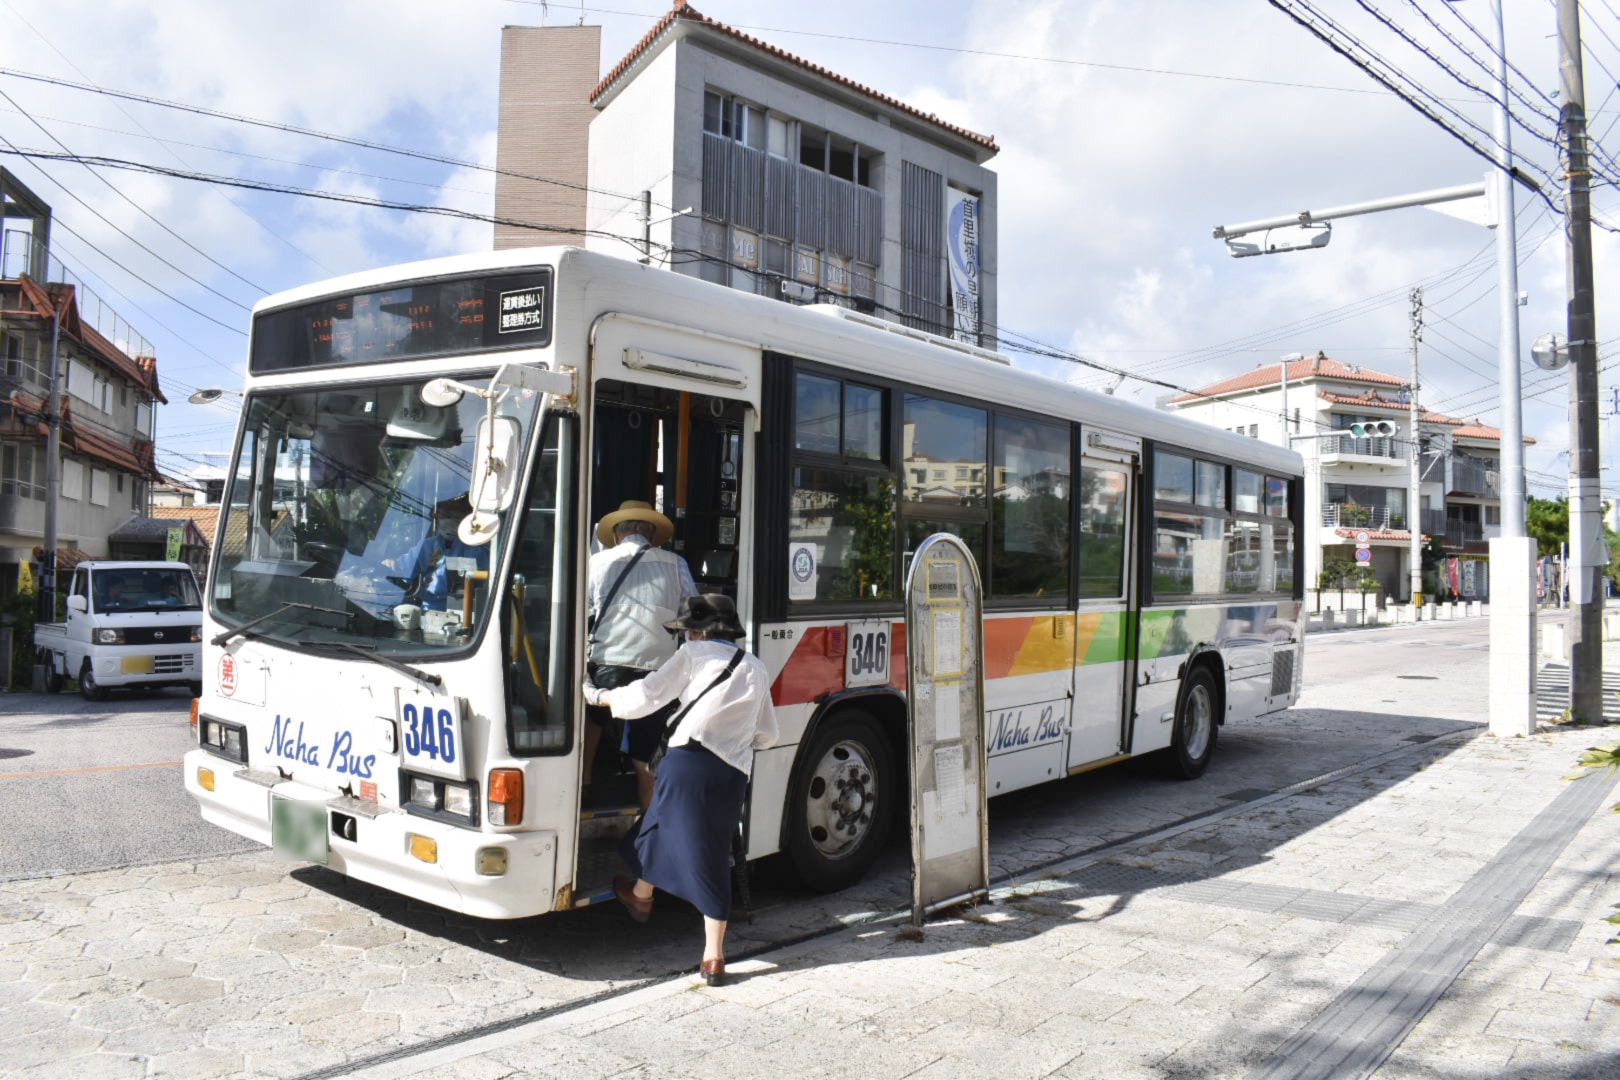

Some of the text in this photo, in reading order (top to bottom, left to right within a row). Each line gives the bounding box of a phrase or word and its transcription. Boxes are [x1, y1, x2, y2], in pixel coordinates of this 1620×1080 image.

[502, 309, 540, 328] 整理券方式
[503, 293, 541, 310] 運賃後払い
[851, 632, 887, 675] 346
[265, 714, 377, 779] Naha Bus
[403, 703, 456, 763] 346
[987, 710, 1031, 753] Naha
[1033, 705, 1065, 742] Bus
